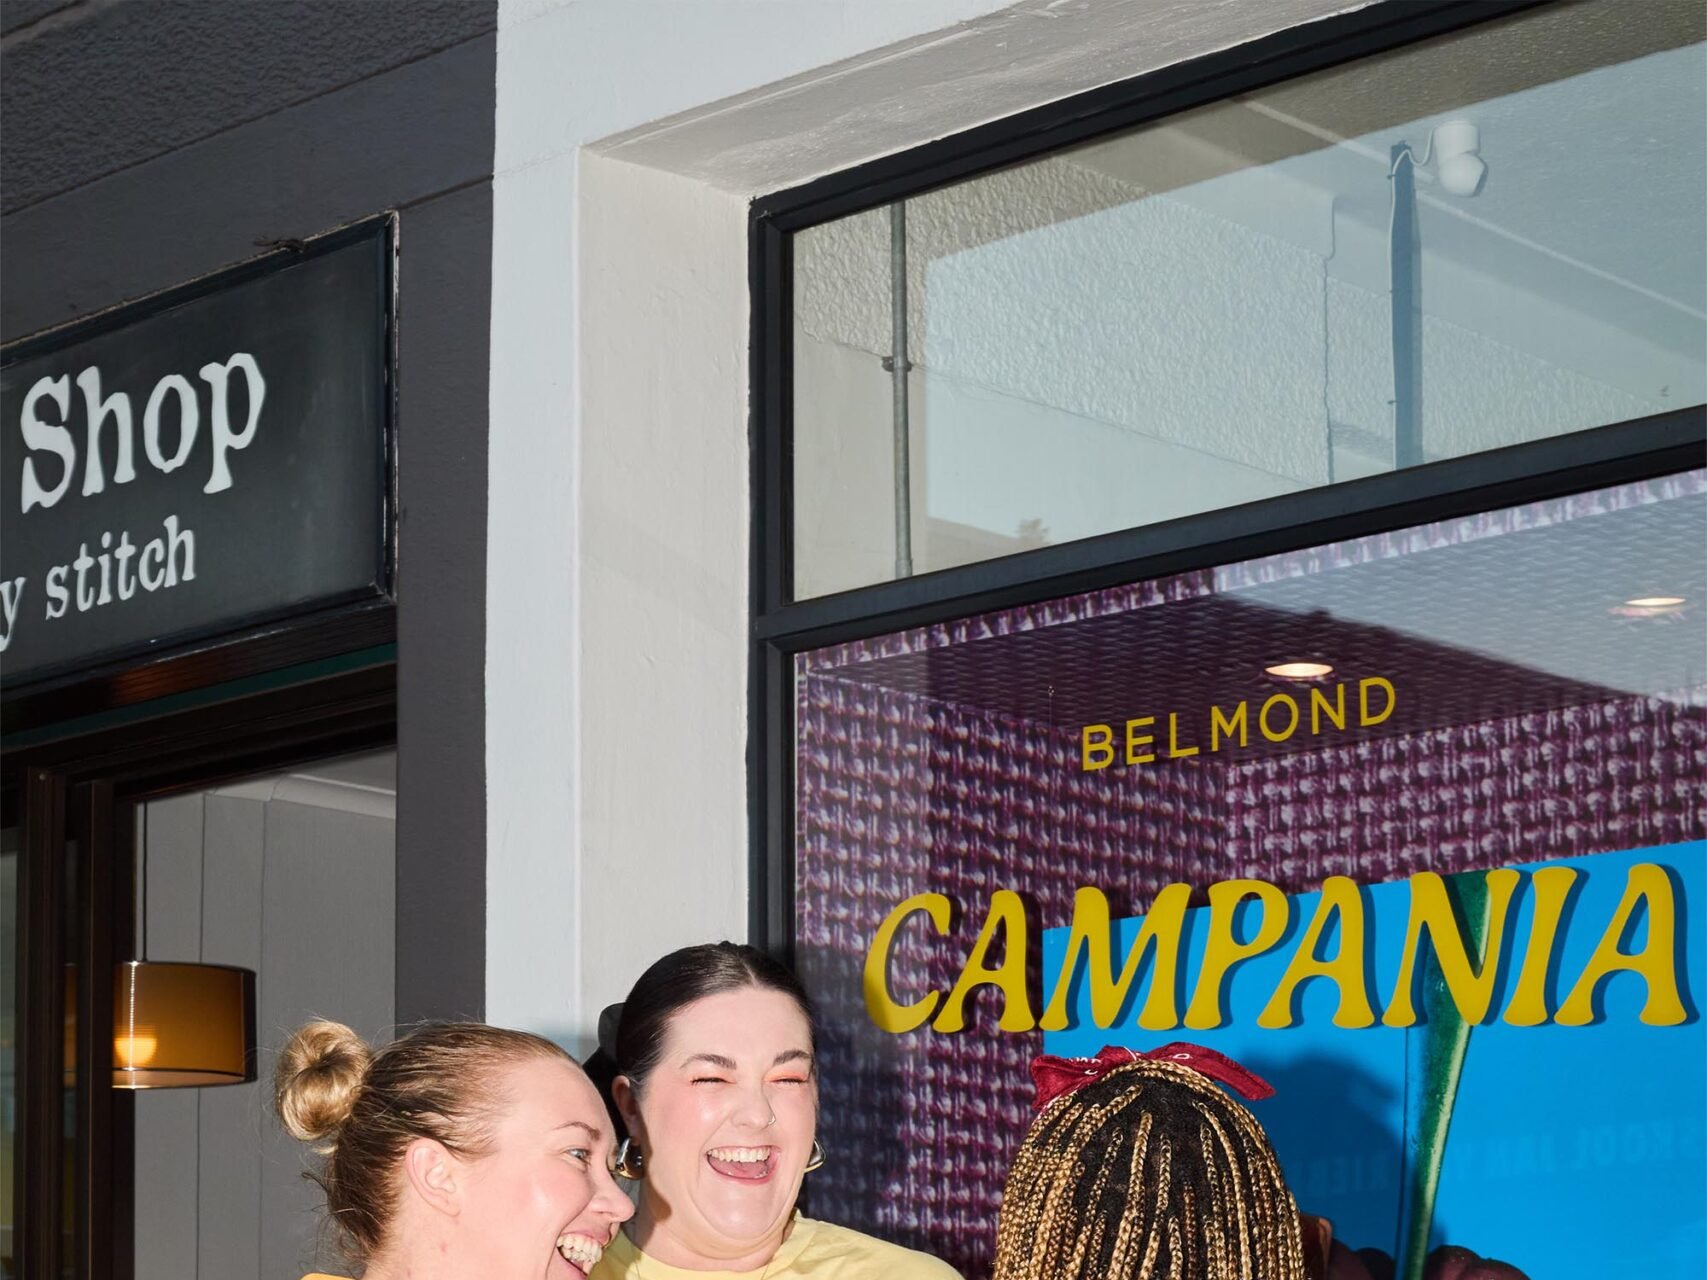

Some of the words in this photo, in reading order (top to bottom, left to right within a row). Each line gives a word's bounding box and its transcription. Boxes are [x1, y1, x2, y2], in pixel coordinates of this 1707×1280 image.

[21, 352, 266, 513] Shop
[46, 515, 195, 619] stitch
[1082, 676, 1396, 771] BELMOND
[863, 863, 1688, 1034] CAMPANIA
